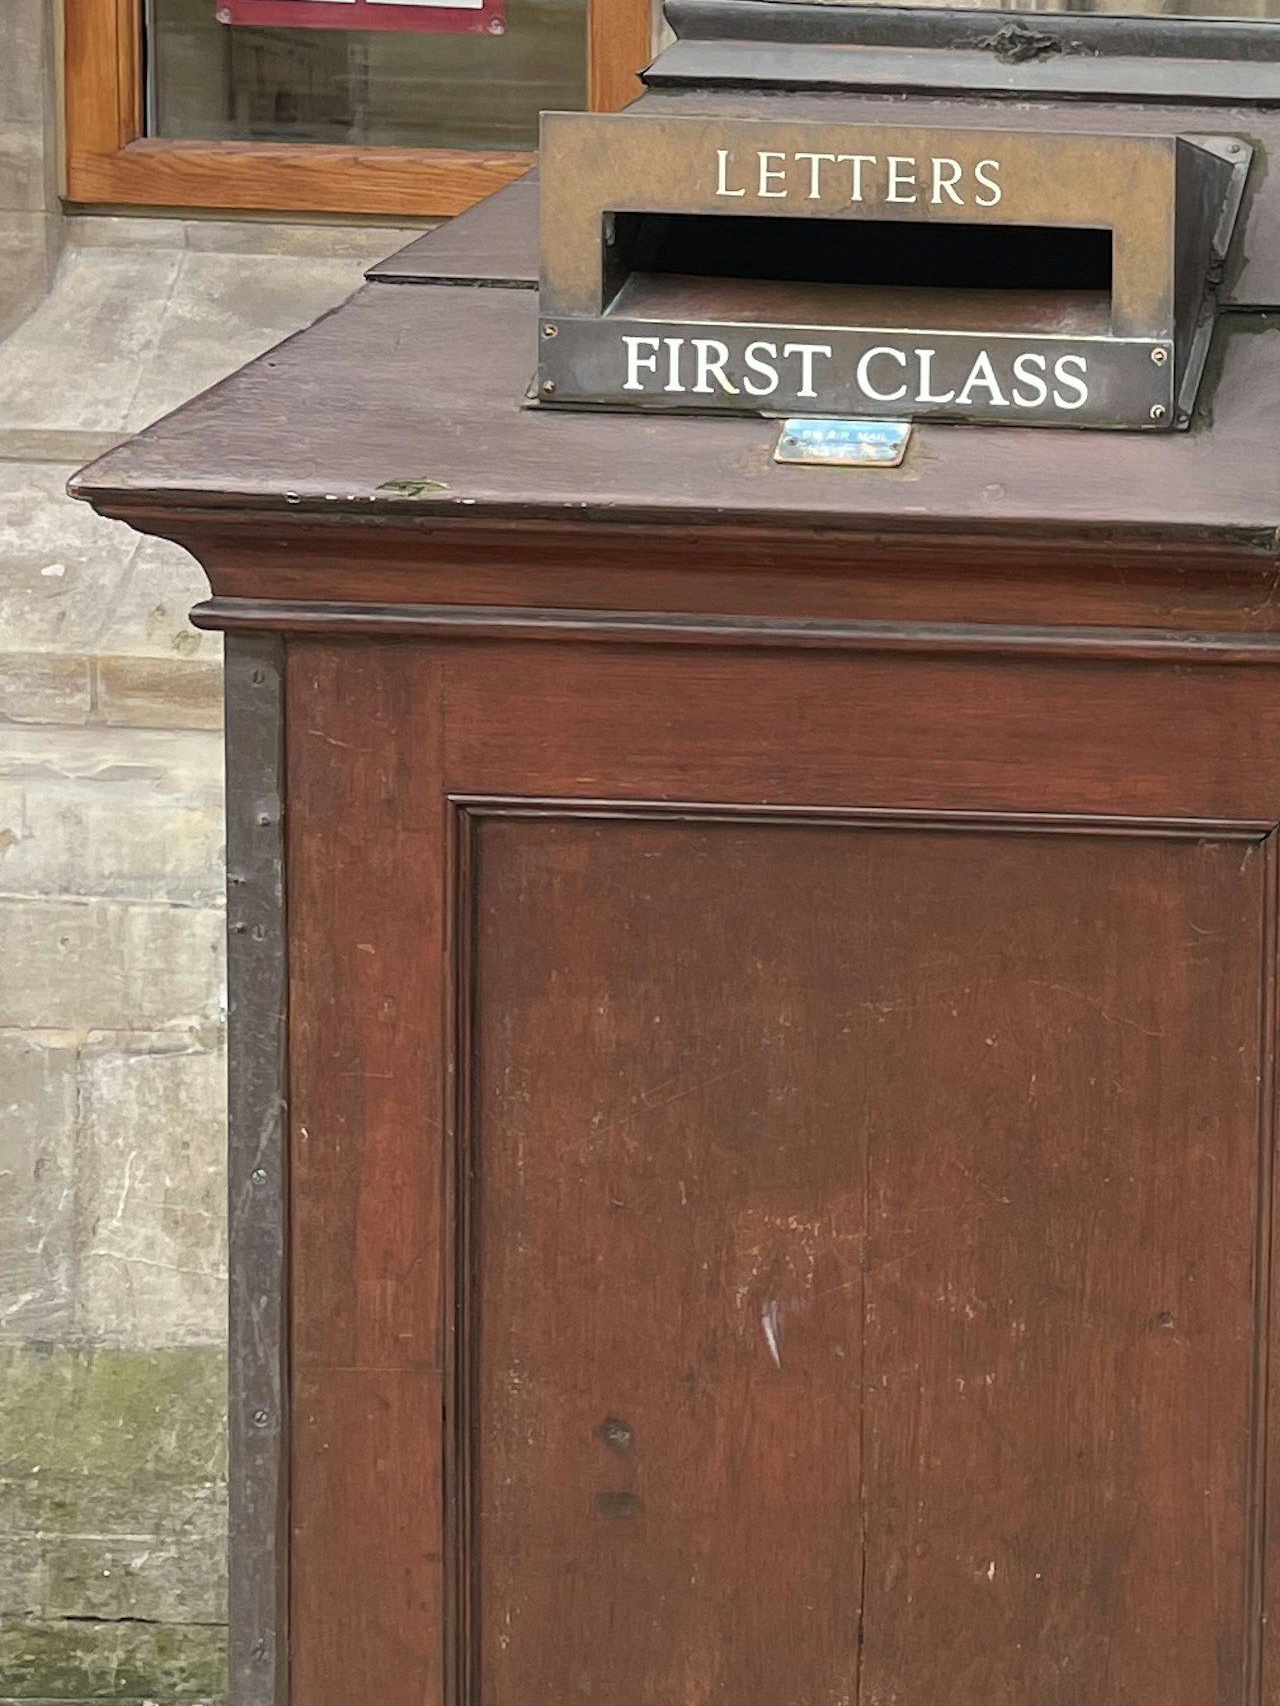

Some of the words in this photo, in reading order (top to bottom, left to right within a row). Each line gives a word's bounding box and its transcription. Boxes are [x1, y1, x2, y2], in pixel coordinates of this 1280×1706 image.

[716, 149, 1003, 208] LETTERS
[622, 336, 833, 398] FIRST
[856, 345, 1090, 410] CLASS
[857, 432, 888, 442] MAIL
